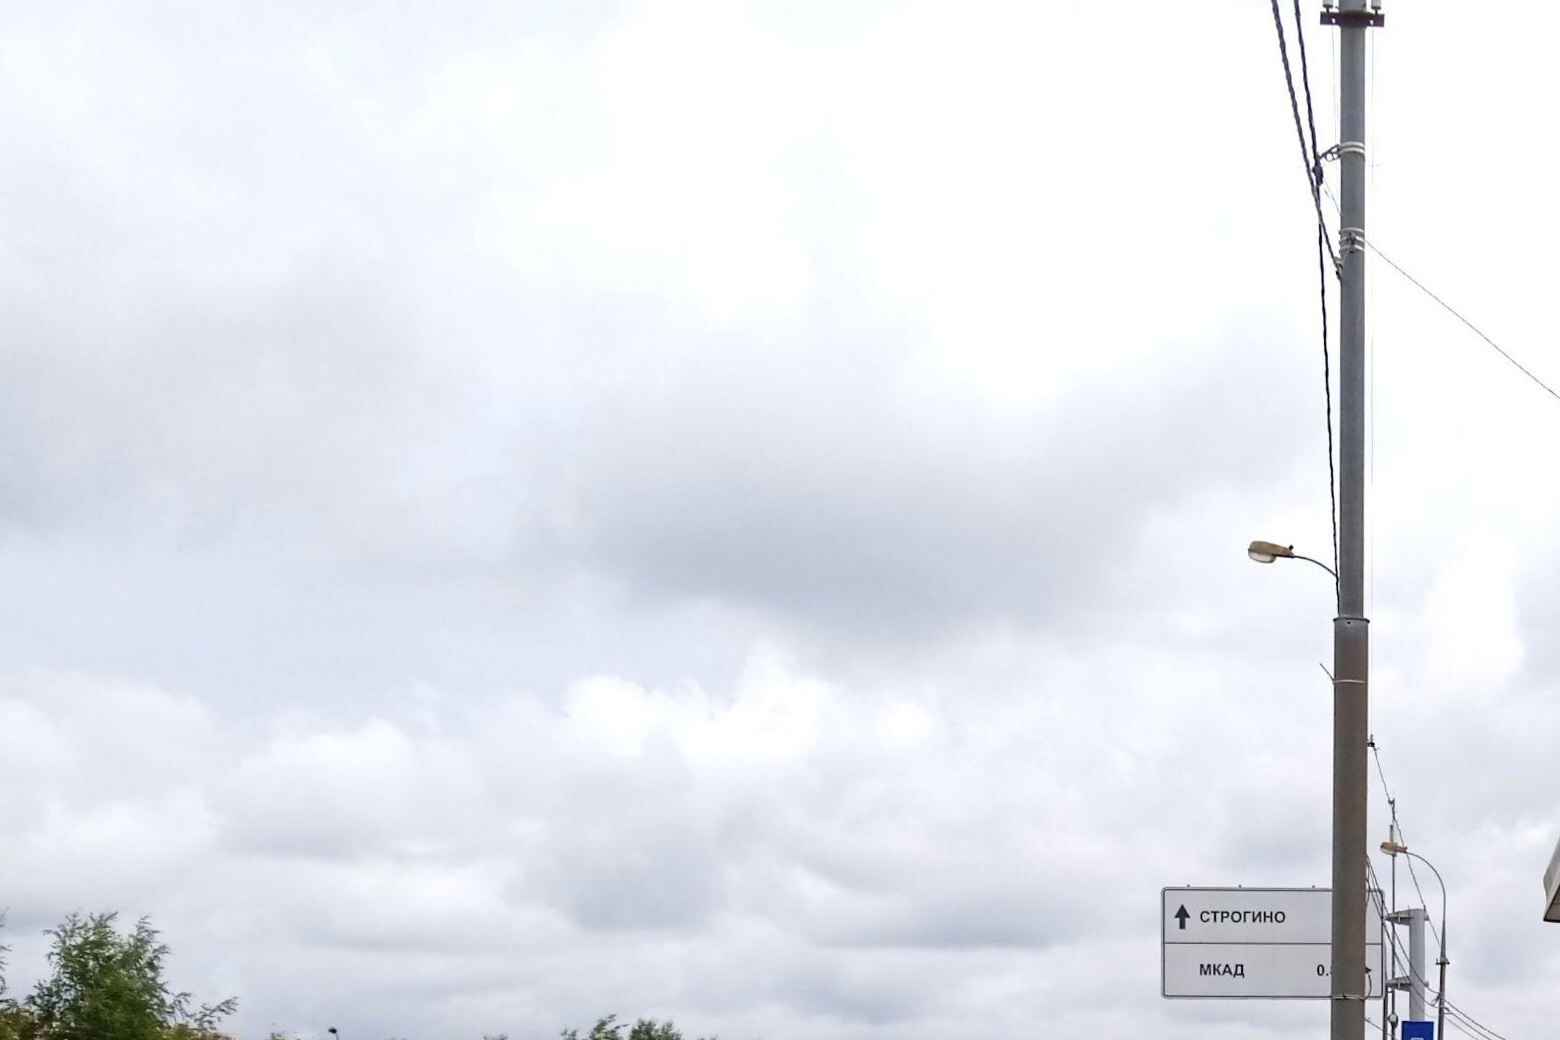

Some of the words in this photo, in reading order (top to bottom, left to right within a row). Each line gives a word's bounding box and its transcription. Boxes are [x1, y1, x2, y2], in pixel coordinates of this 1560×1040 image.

[1199, 910, 1287, 924] СТРОГИНО
[1199, 963, 1245, 979] МКАД
[1316, 964, 1333, 977] 0.
